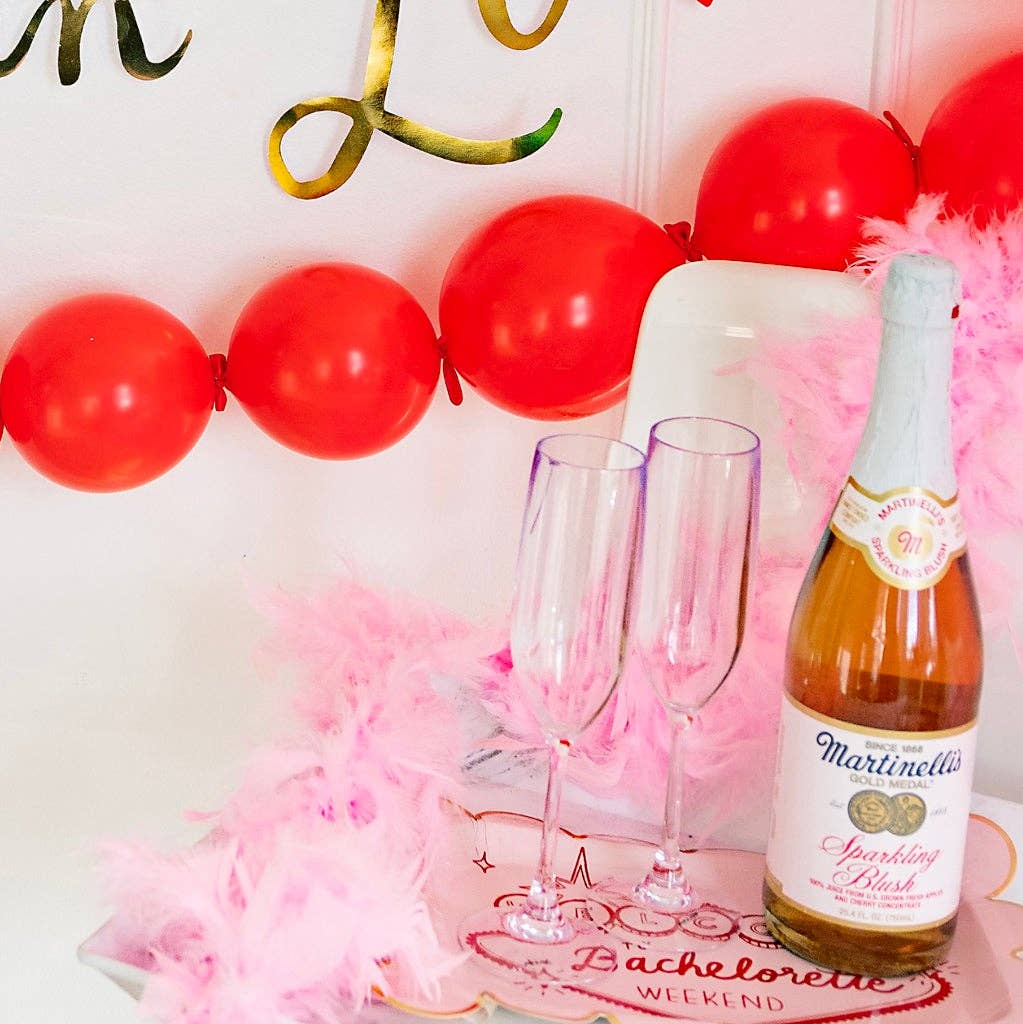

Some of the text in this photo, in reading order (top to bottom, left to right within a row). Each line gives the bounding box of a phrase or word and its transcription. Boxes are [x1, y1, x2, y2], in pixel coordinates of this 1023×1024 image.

[816, 731, 961, 777] Martinelli's
[865, 741, 923, 753] SINCE 1868
[849, 774, 885, 787] GOLD
[820, 835, 941, 873] Sparkling
[832, 863, 917, 893] Blush
[571, 944, 904, 993] Bachelorette
[637, 985, 784, 1011] WEEKEND
